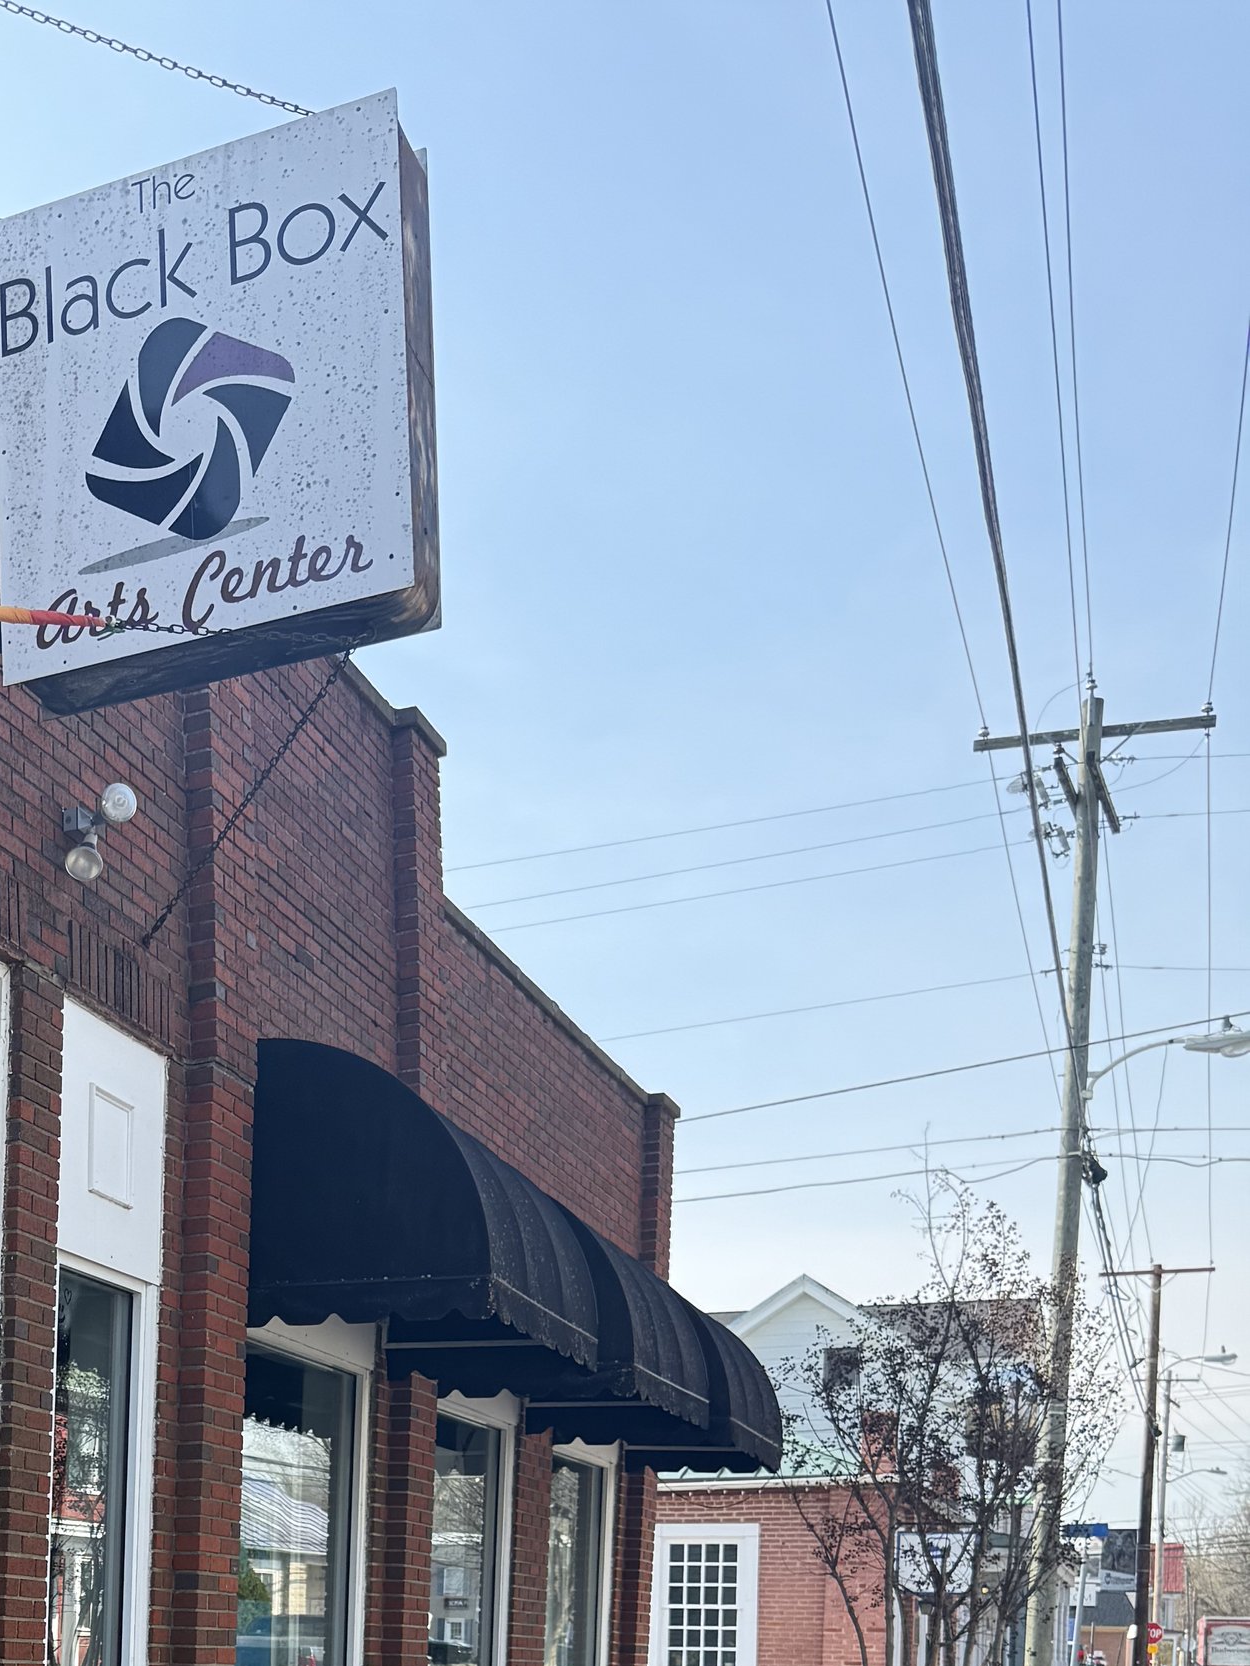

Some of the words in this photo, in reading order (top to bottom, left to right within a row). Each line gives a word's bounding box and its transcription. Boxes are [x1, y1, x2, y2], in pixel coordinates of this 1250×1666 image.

[131, 173, 196, 214] The
[0, 228, 198, 358] Black
[227, 181, 389, 286] Box
[36, 581, 159, 650] Arts
[182, 534, 374, 632] Center
